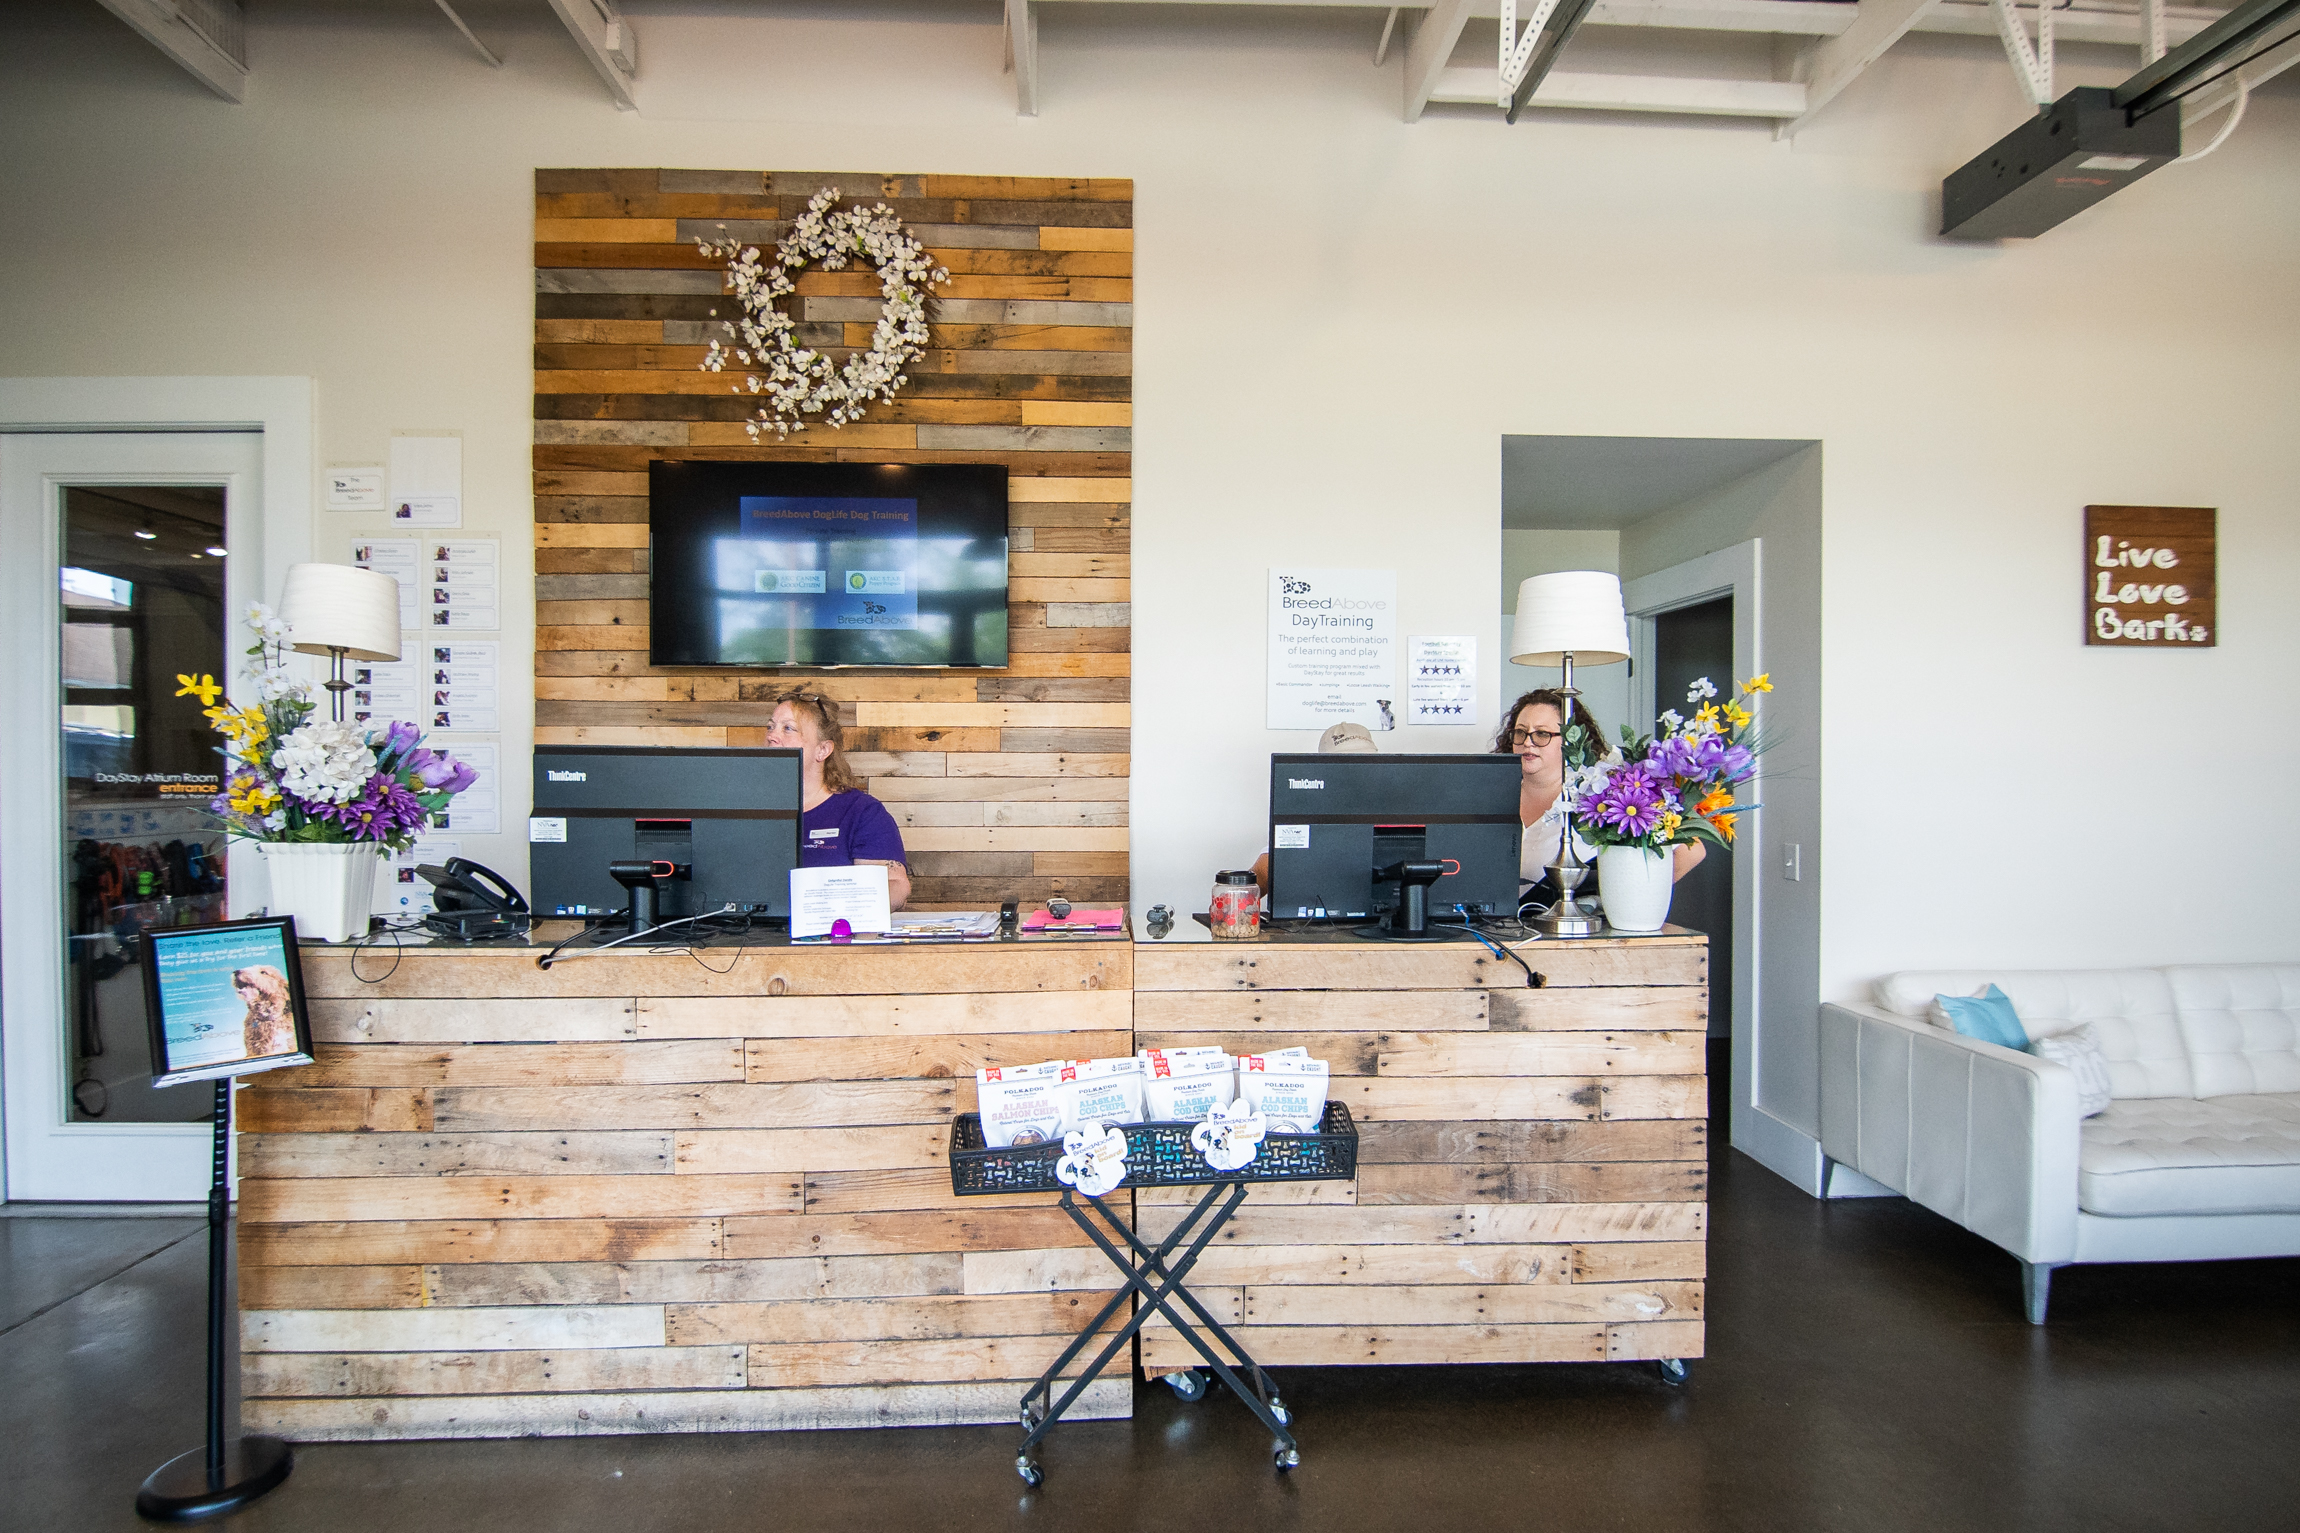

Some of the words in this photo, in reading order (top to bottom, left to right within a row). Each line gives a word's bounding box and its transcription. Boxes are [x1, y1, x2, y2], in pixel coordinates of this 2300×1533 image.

[752, 509, 810, 519] BreedAbove
[813, 509, 848, 521] DogLife
[850, 510, 869, 522] Dog
[872, 510, 909, 522] Training
[2095, 535, 2181, 569] Live
[2095, 571, 2190, 605] Love
[1282, 596, 1387, 610] BreedAbove
[838, 615, 912, 625] BreedAbove
[1292, 613, 1374, 631] DayTraining
[2095, 607, 2190, 641] Bark
[1278, 634, 1294, 643] The
[1297, 635, 1329, 645] perfect
[1330, 635, 1388, 644] combination
[1288, 646, 1298, 655] of
[1299, 646, 1337, 658] learning
[1339, 648, 1356, 656] and
[1358, 648, 1378, 658] play
[95, 772, 143, 784] DayStay
[182, 773, 218, 782] Room
[547, 770, 586, 782] ThinkCentre
[160, 783, 218, 793] entrance
[1288, 778, 1324, 790] ThinkCentre
[1004, 1086, 1044, 1094] POLKADOG
[1078, 1084, 1118, 1094] POLKADOG
[1174, 1082, 1212, 1091] POLKADOG
[1003, 1100, 1048, 1112] ALASKAN
[1080, 1094, 1123, 1108] ALASKAN
[1174, 1095, 1217, 1108] ALASKAN
[1262, 1096, 1308, 1104] ALASKAN
[992, 1109, 1032, 1121] SALMON
[1034, 1106, 1060, 1116] CHIPS
[1080, 1106, 1098, 1116] COD
[1100, 1102, 1126, 1112] CHIPS
[1174, 1106, 1192, 1116] COD
[1282, 1104, 1308, 1113] CHIPS
[1214, 1118, 1258, 1126] BreedAbove
[1072, 1136, 1116, 1156] BreedAbove
[1094, 1144, 1107, 1154] kid
[1098, 1148, 1124, 1162] board!
